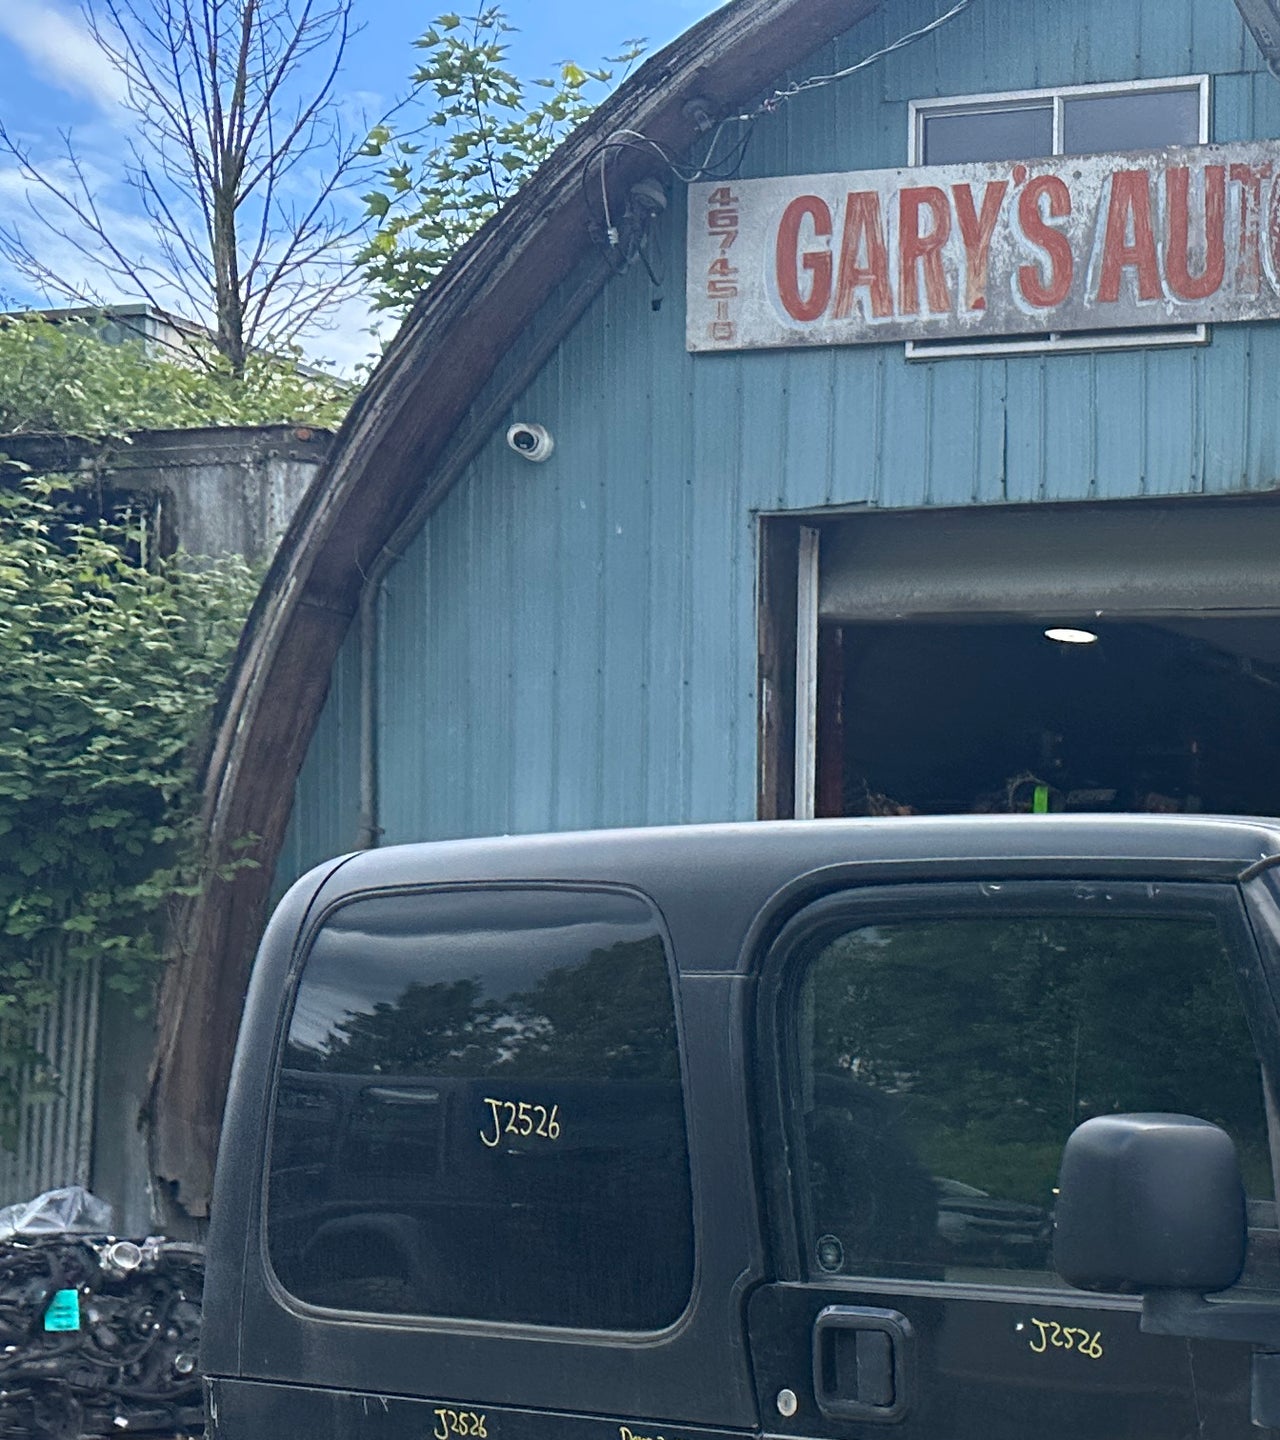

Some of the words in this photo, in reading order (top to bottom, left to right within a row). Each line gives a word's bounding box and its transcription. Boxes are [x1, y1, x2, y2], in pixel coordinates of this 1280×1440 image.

[772, 164, 1074, 323] GARY'S
[480, 1098, 560, 1147] J2526
[1030, 1317, 1103, 1358] J2526
[434, 1408, 488, 1440] J2526
